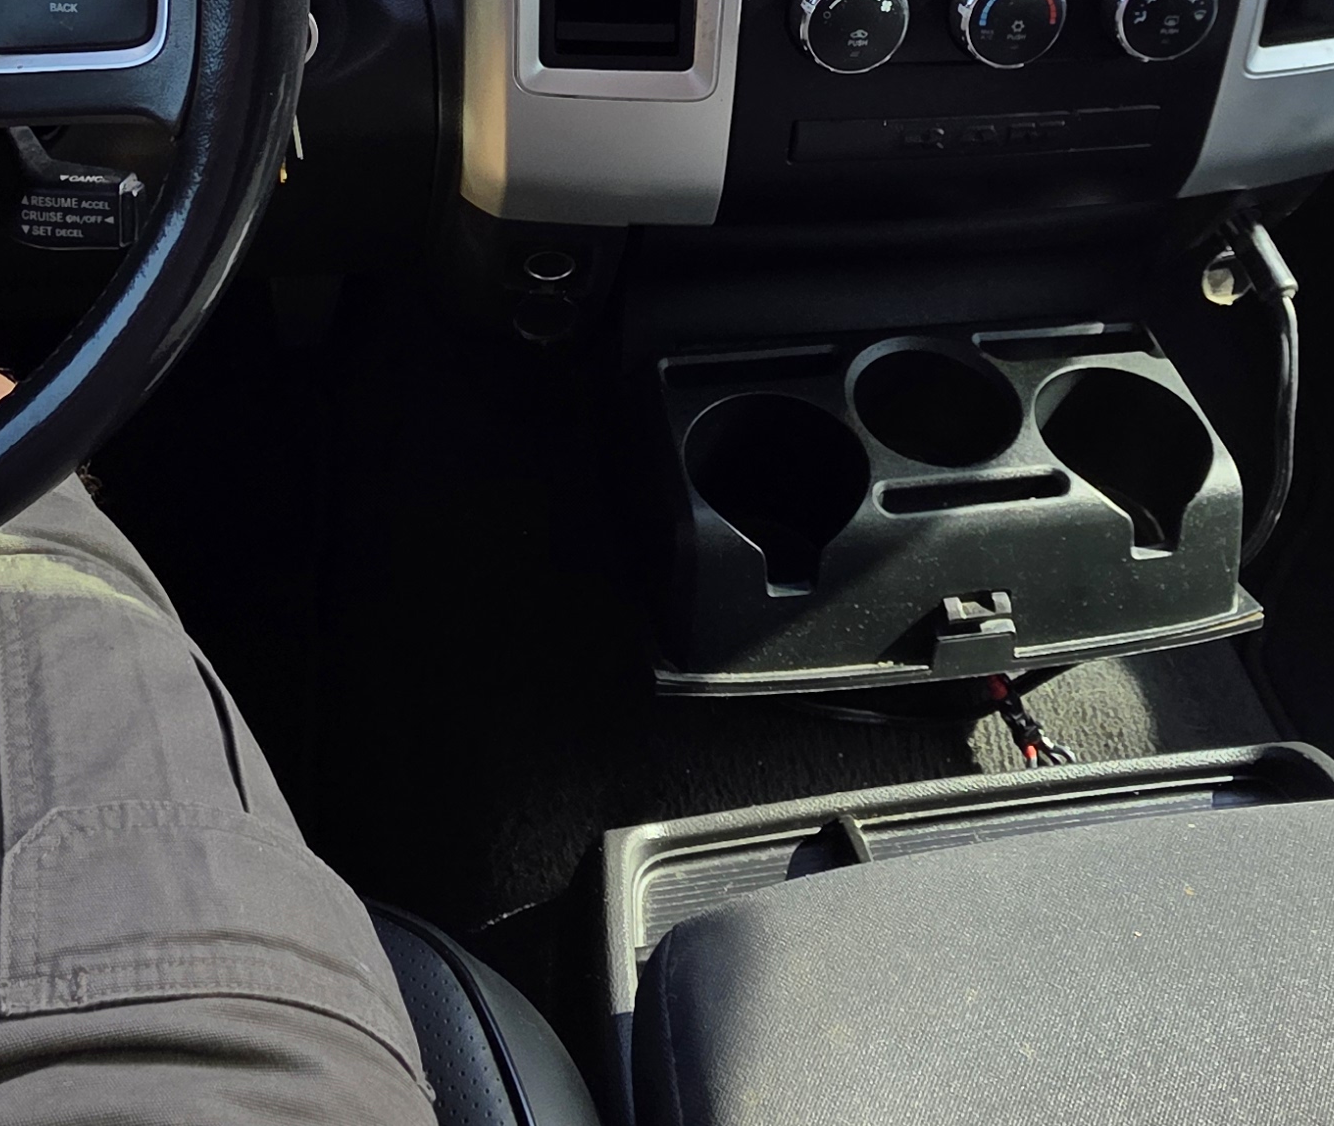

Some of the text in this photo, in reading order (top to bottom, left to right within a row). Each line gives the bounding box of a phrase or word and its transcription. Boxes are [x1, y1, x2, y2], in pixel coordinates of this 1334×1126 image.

[49, 2, 78, 14] BACK
[848, 39, 869, 47] PUSH
[69, 175, 120, 184] CANC
[31, 196, 111, 210] RESUME ACCEL
[21, 209, 103, 225] CRUISE ON/OFF
[32, 225, 84, 238] SET DECEL
